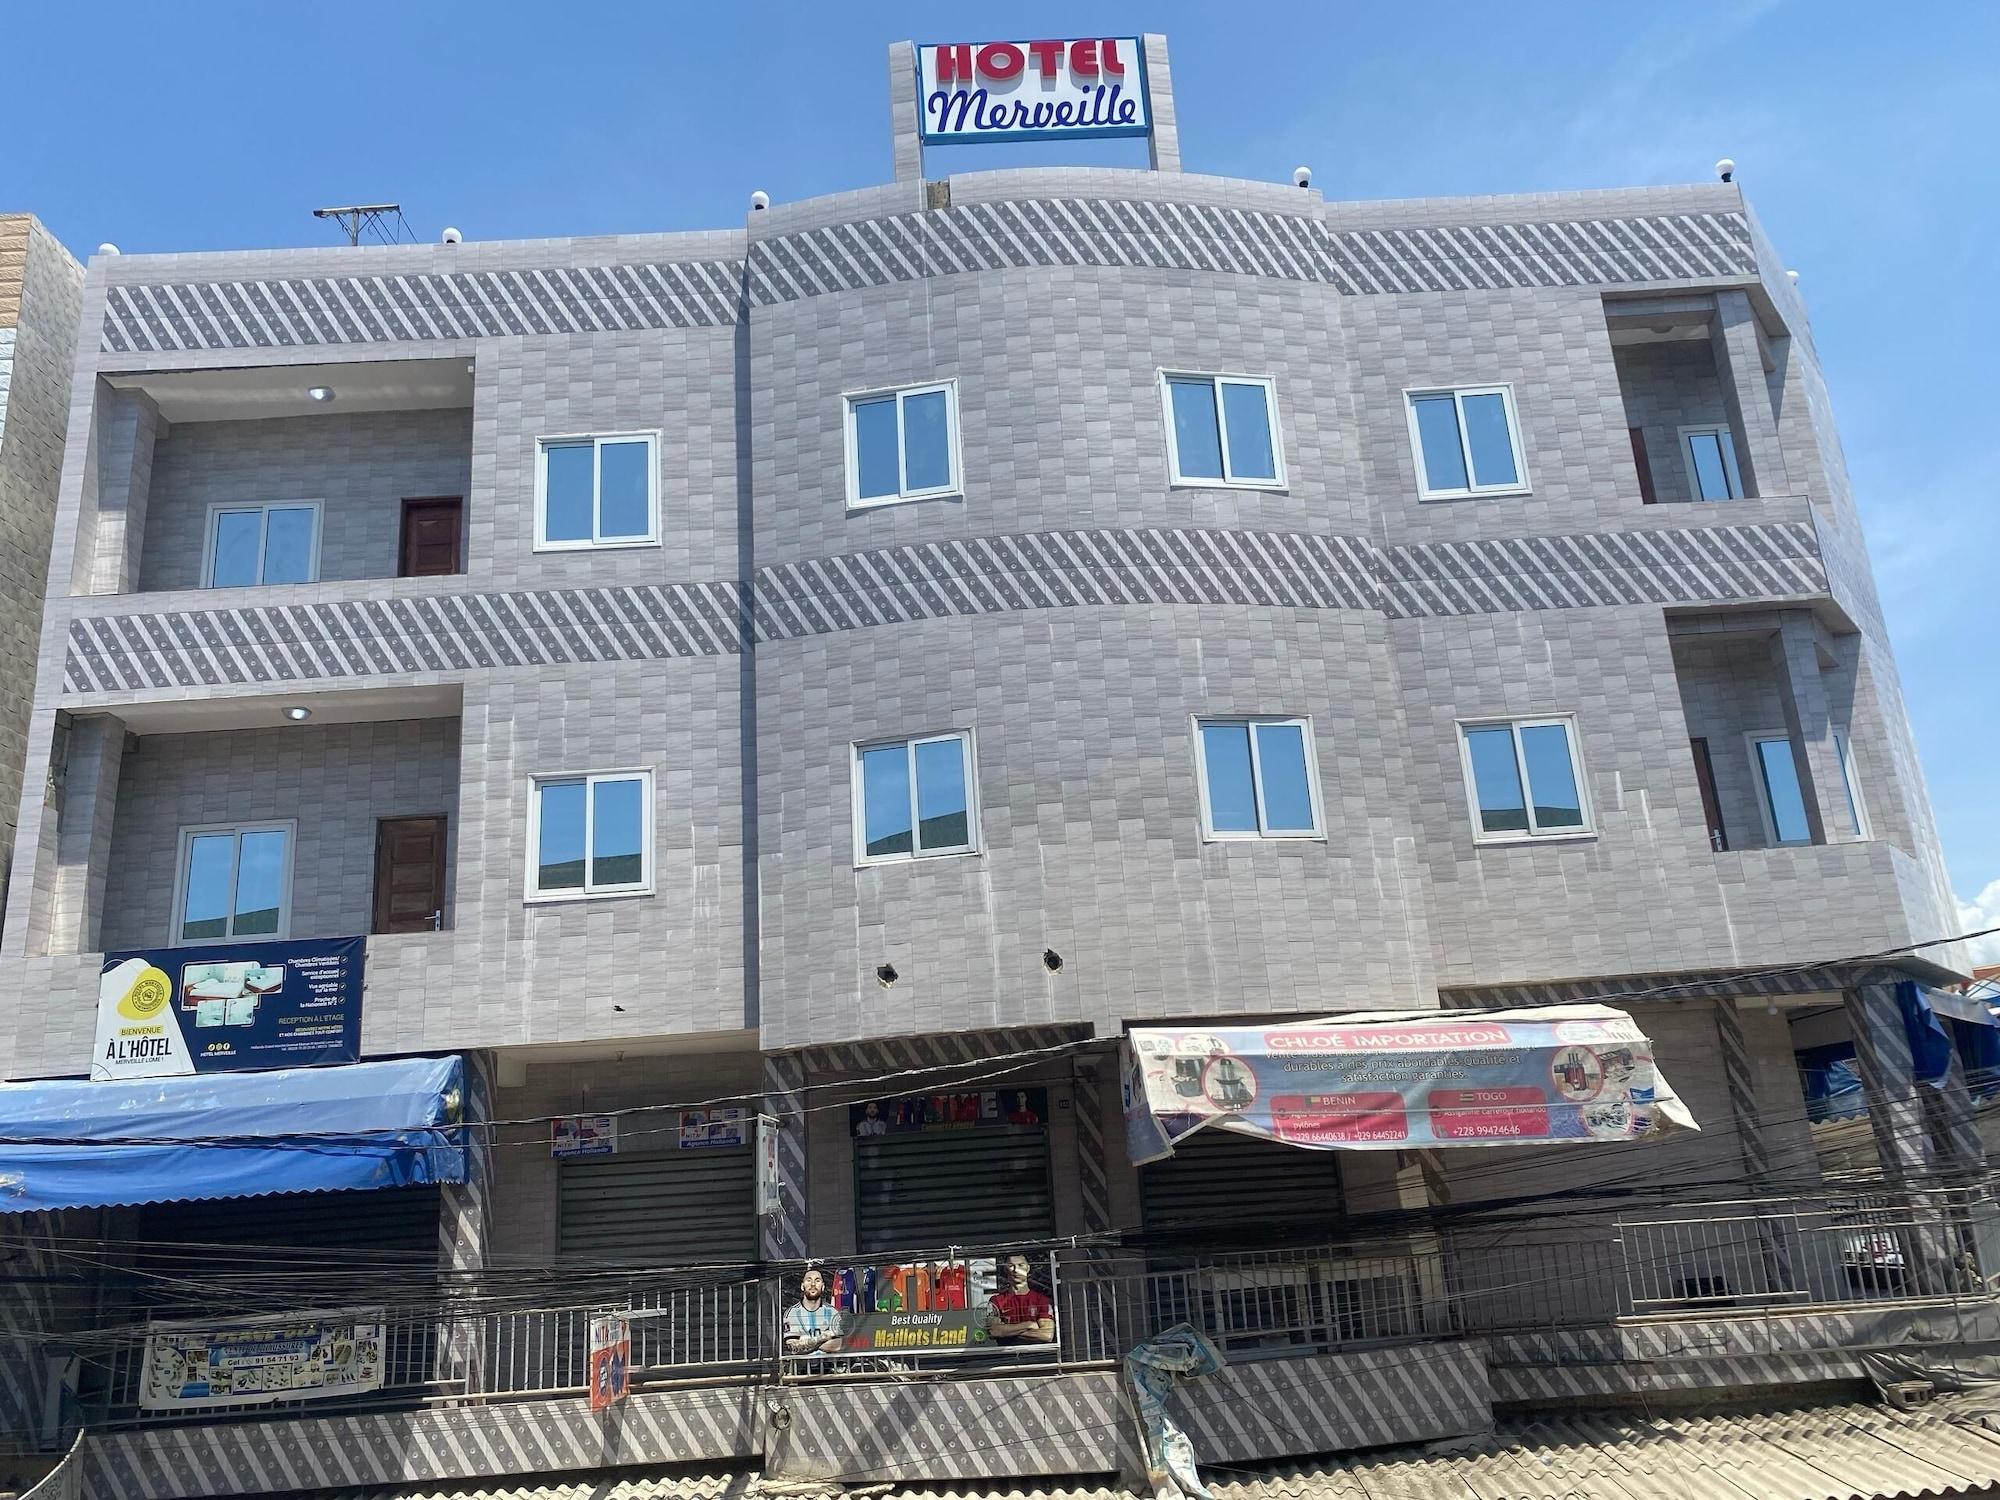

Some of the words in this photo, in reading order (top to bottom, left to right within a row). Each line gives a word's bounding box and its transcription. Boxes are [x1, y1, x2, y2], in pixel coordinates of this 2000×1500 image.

[936, 40, 1125, 84] HOTEL
[928, 85, 1136, 132] Merveille
[121, 1026, 162, 1036] BIENVENUE
[1270, 1034, 1346, 1048] CHLOÉ
[106, 1038, 116, 1060] À
[118, 1036, 172, 1058] L'HÔTEL
[1284, 1061, 1334, 1072] durables
[1348, 1059, 1368, 1070] des
[1372, 1060, 1393, 1072] prix
[1342, 1071, 1408, 1083] satisfaction
[1323, 1097, 1356, 1106] BENIN
[1477, 1093, 1507, 1101] TOGO
[1311, 1132, 1346, 1141] 66440638
[1372, 1130, 1407, 1140] 64452241
[1452, 1127, 1475, 1136] +228
[1476, 1125, 1521, 1135] 99424646
[891, 1315, 911, 1326] Best
[911, 1313, 943, 1325] Quality
[874, 1328, 930, 1348] Maillots
[932, 1325, 968, 1345] Land
